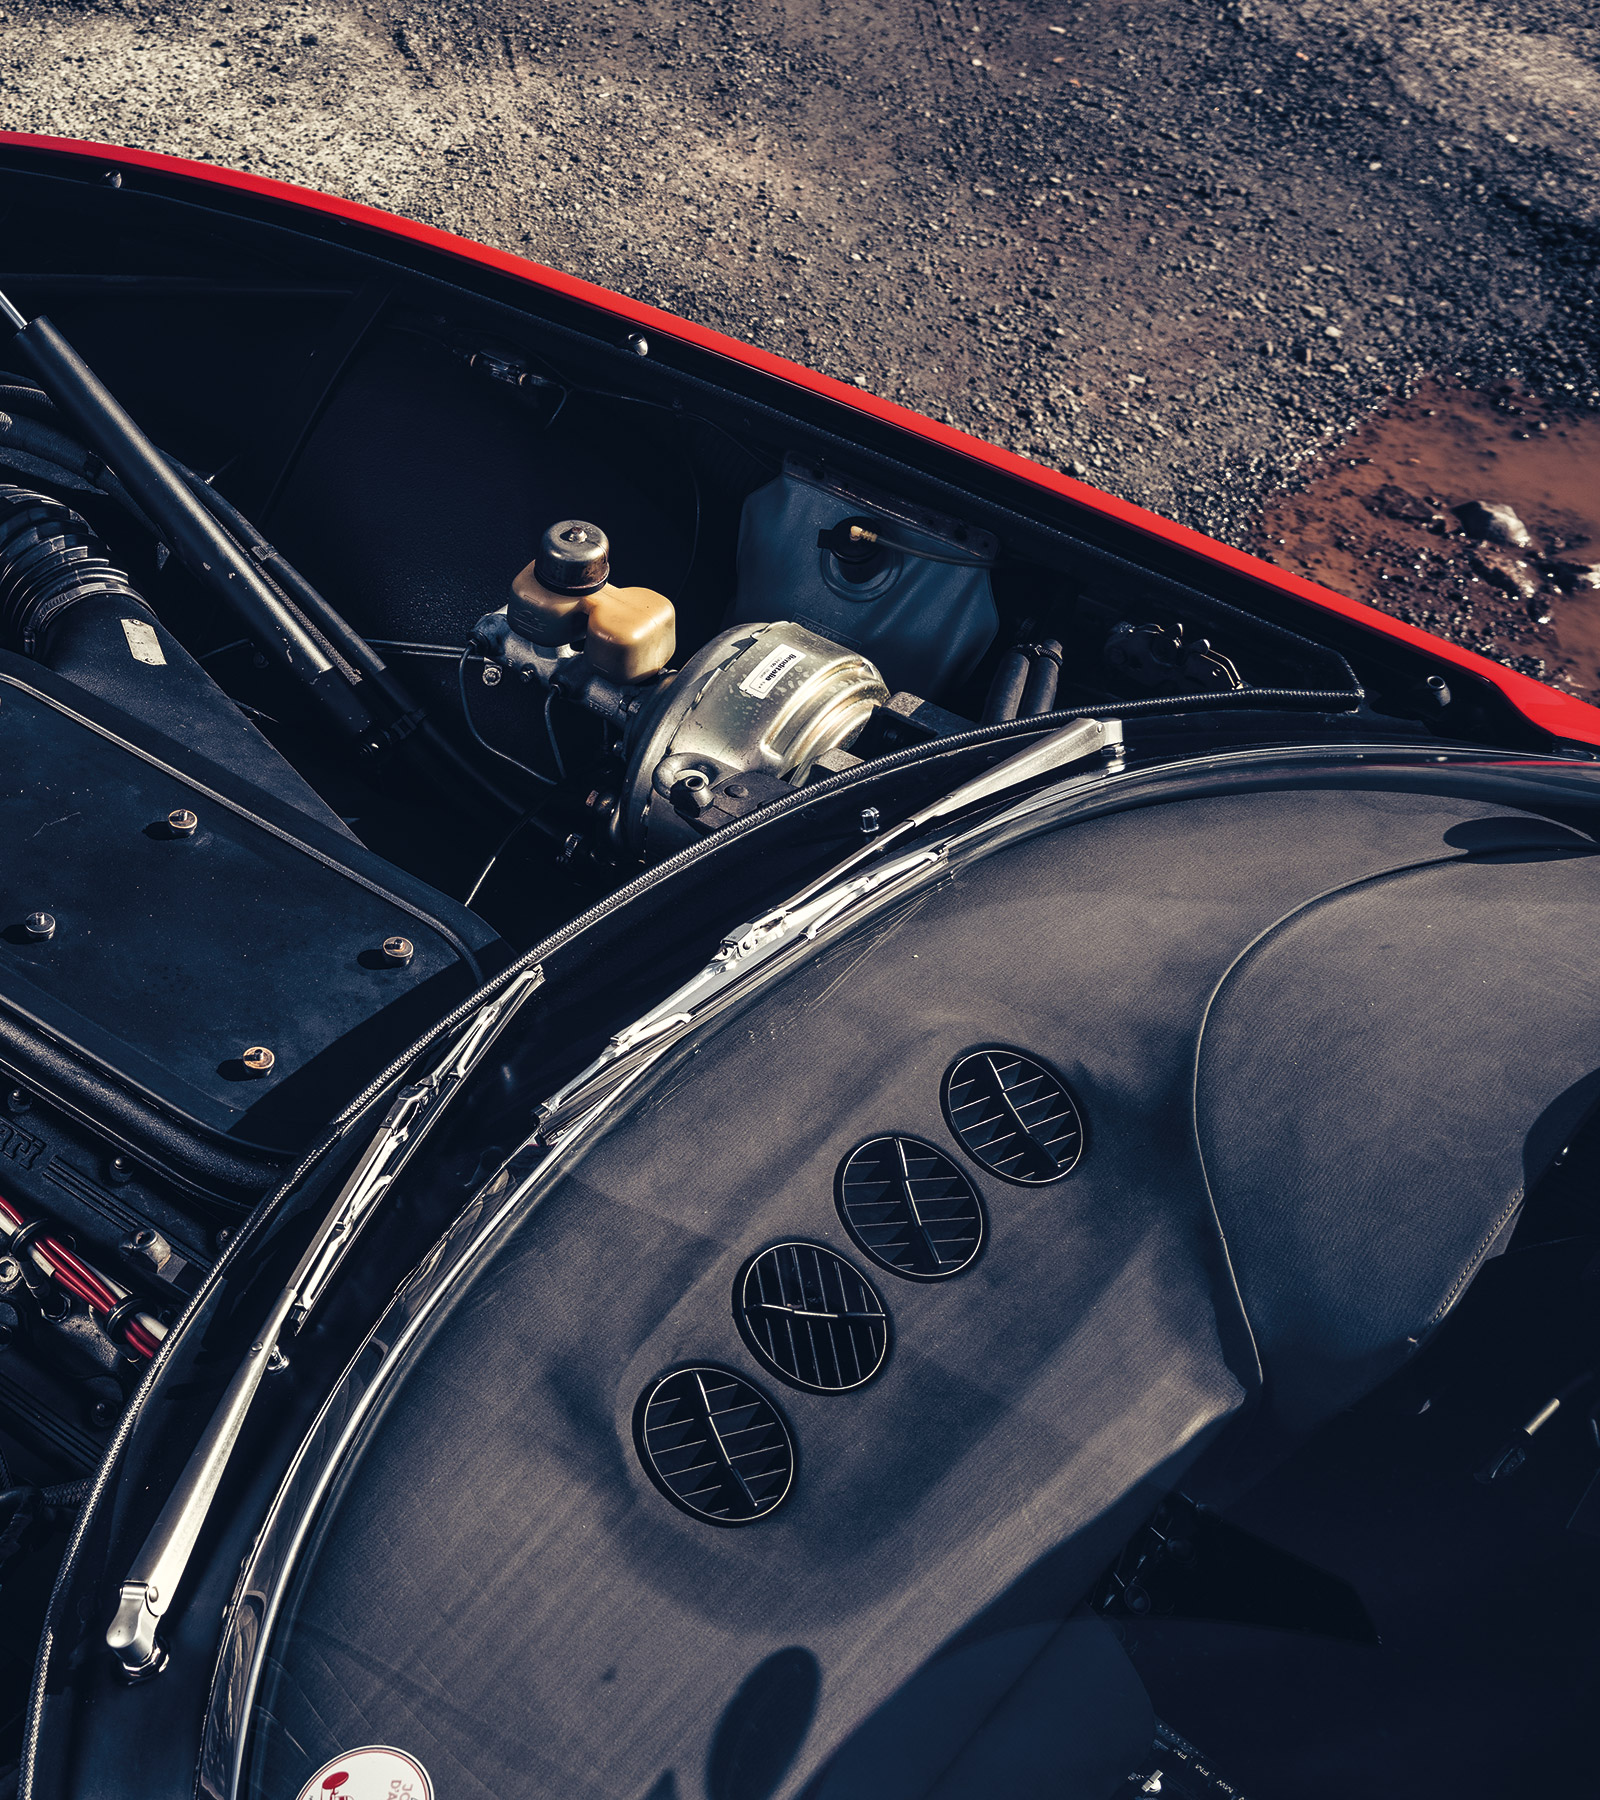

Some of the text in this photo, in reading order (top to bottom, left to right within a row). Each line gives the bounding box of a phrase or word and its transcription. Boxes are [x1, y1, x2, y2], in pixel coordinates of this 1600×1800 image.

[764, 653, 797, 682] Benditalia
[1194, 1763, 1210, 1776] FM
[1215, 1778, 1234, 1793] MW
